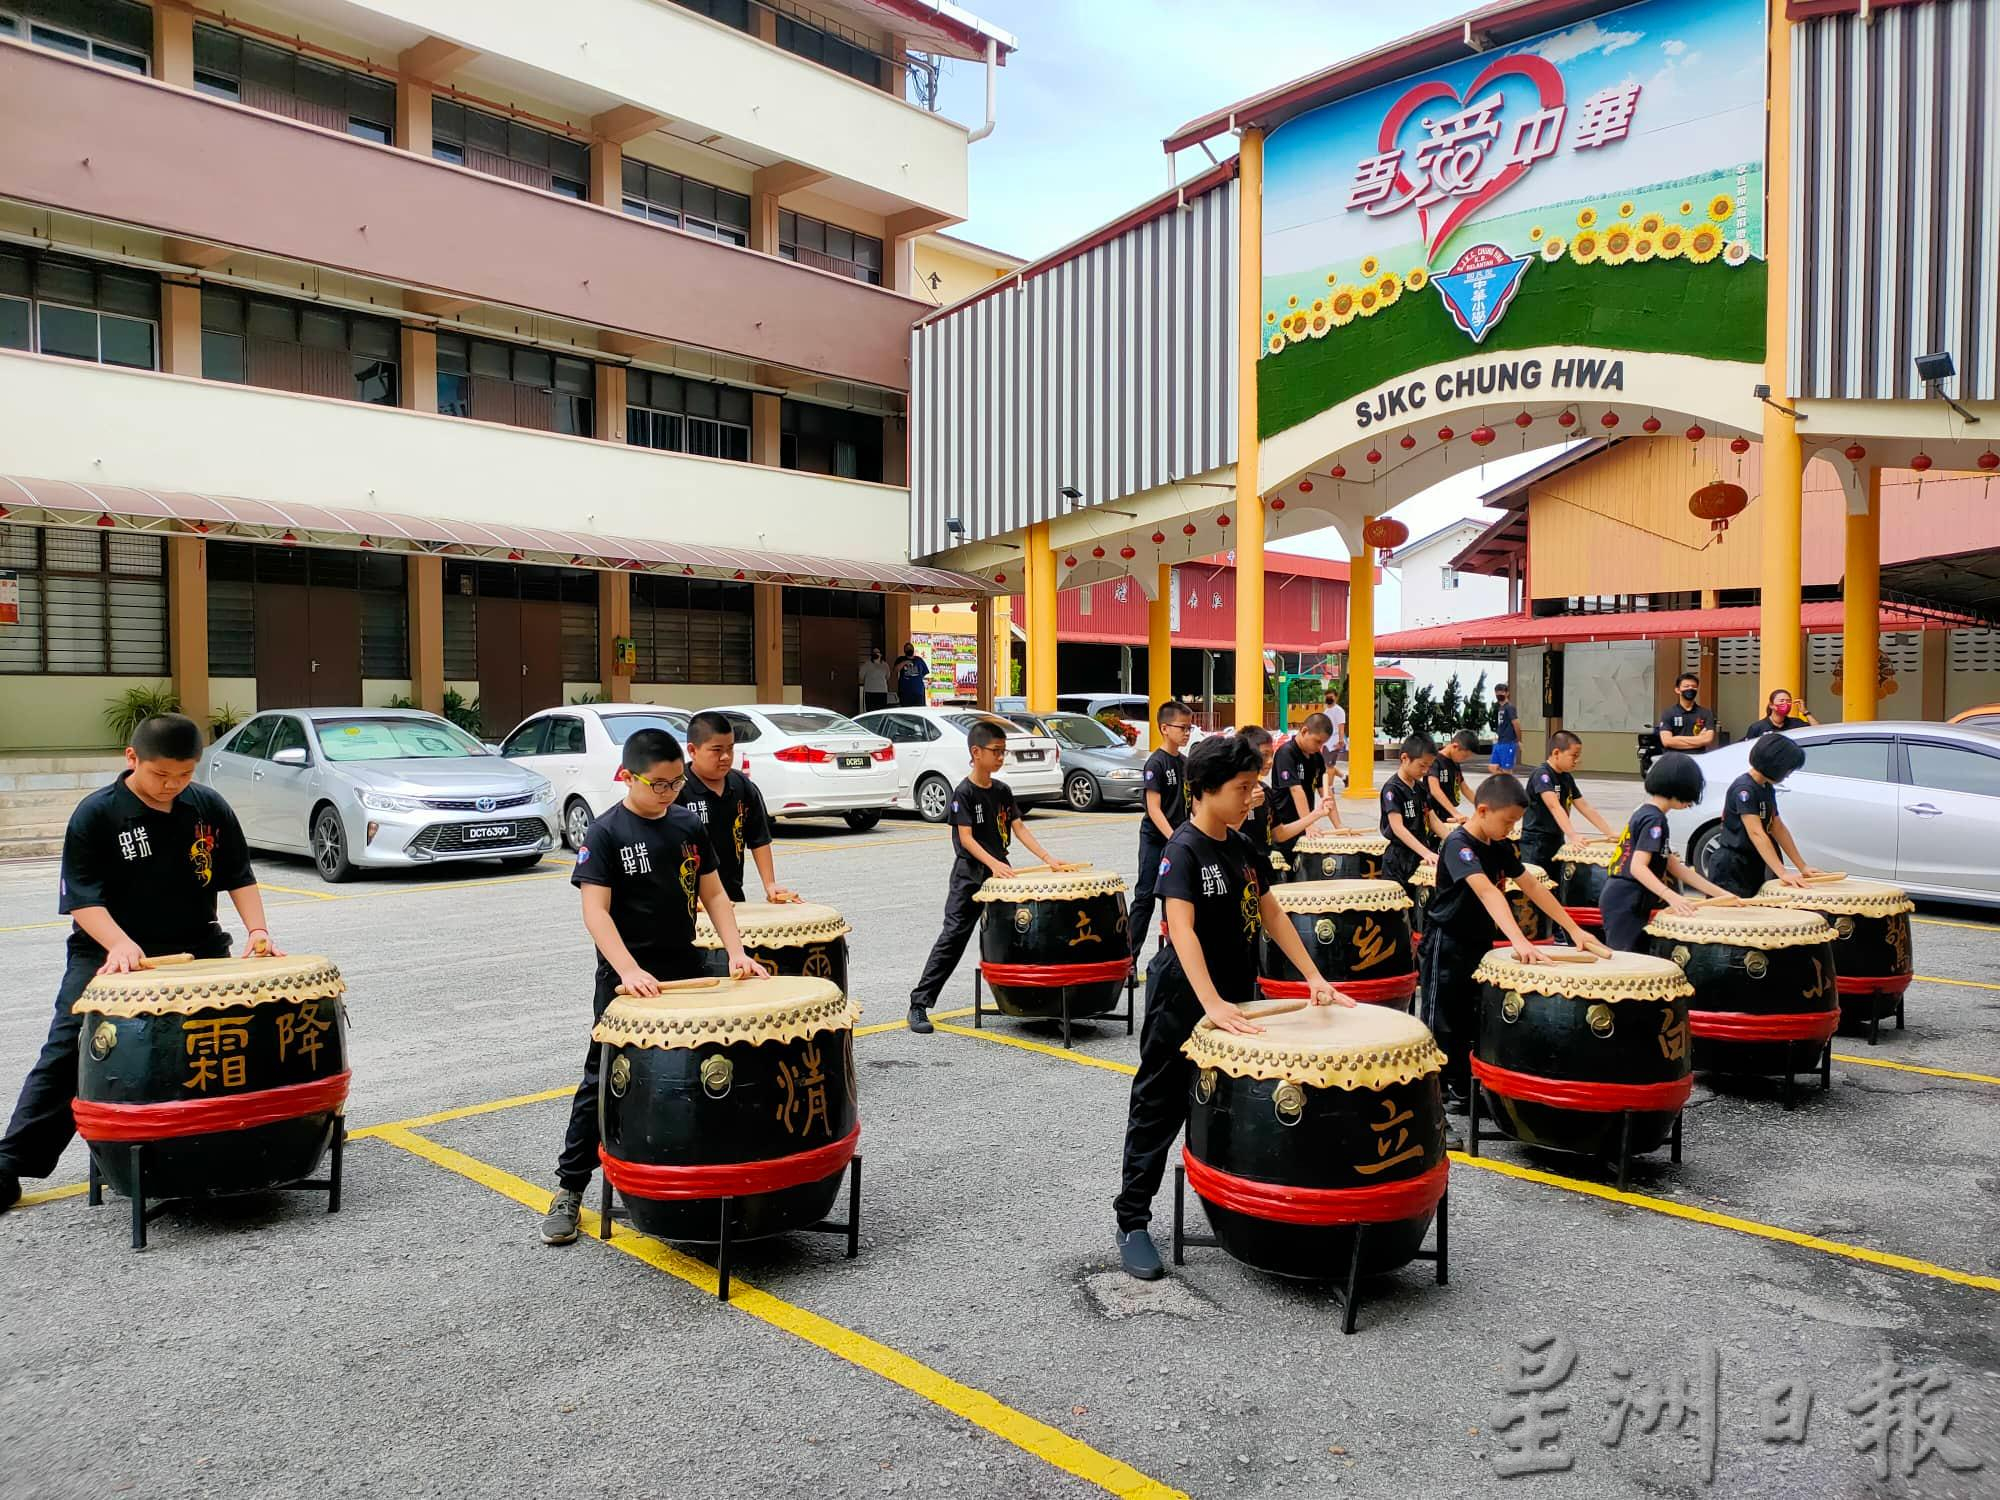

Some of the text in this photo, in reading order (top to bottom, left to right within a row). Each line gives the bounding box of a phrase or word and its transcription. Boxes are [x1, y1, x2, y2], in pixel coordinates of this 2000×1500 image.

[1356, 358, 1624, 428] SJKC CHUNG HWA
[470, 826, 509, 838] DCT6399
[182, 1003, 331, 1092] 霜降
[1353, 1099, 1424, 1174] 立
